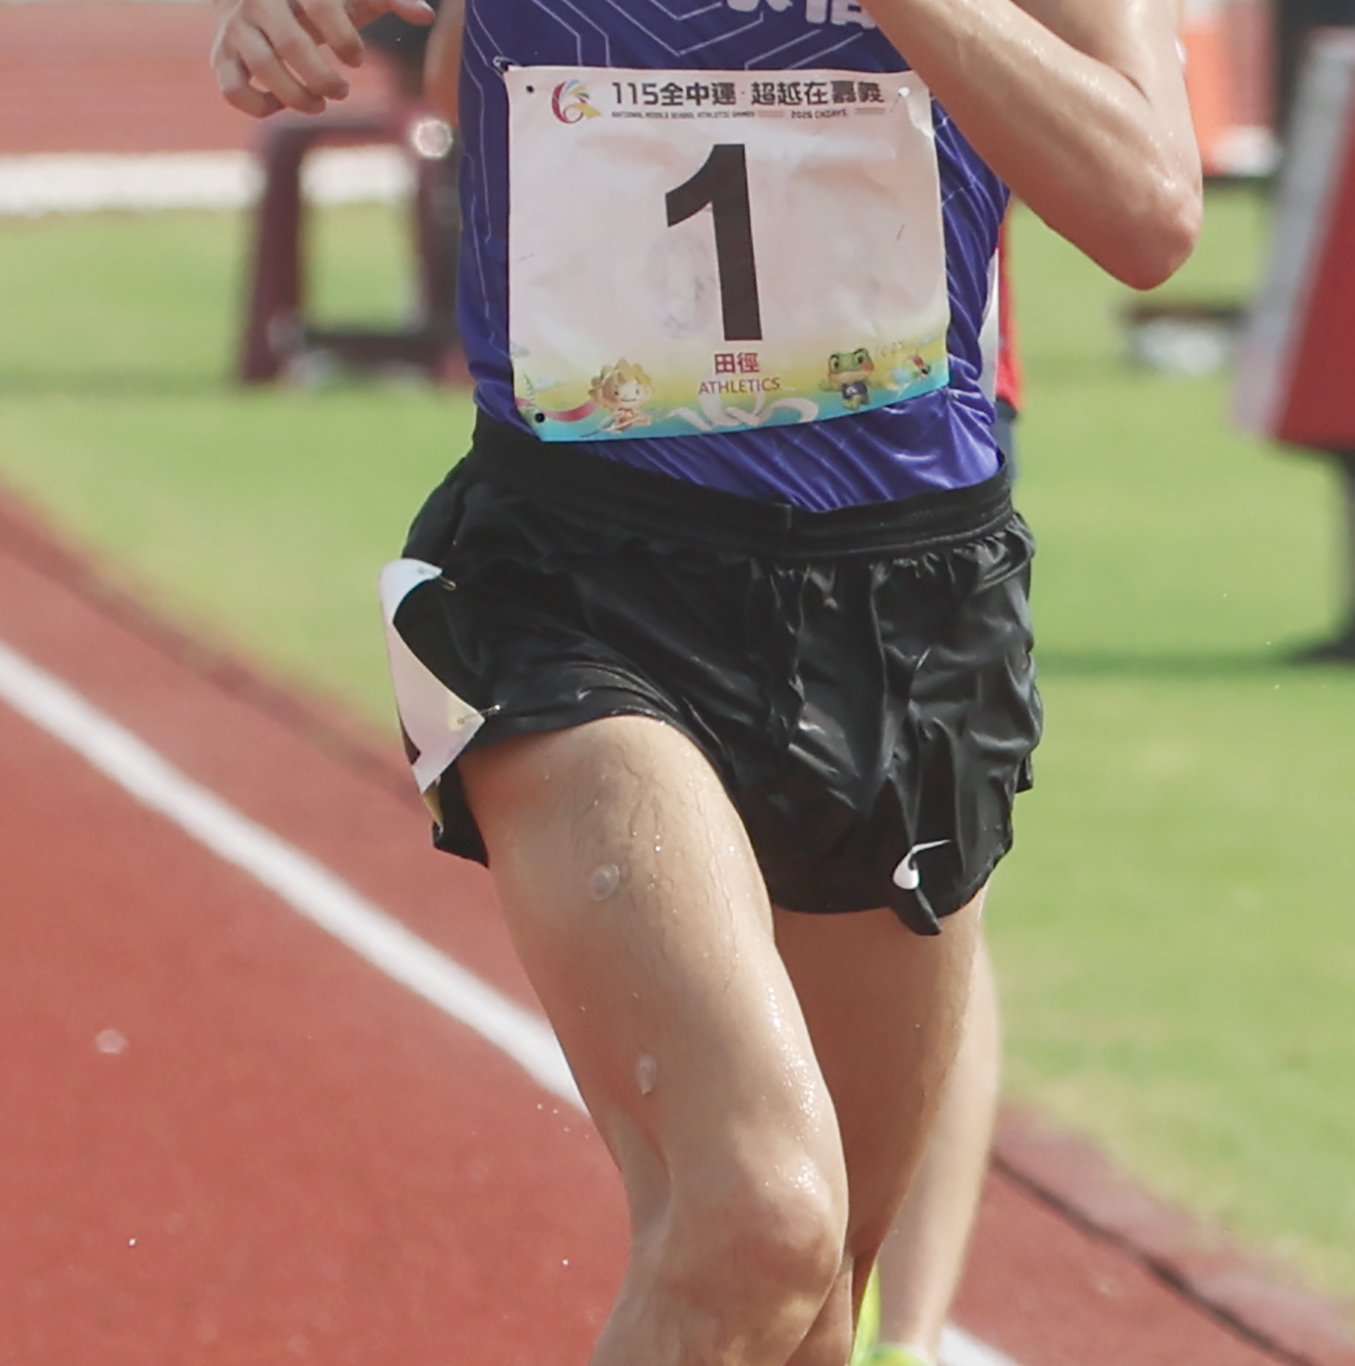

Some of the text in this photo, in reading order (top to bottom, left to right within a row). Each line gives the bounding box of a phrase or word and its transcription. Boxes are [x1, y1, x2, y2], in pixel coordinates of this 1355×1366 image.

[665, 143, 763, 341] 1
[714, 352, 761, 374] 田徑
[698, 376, 781, 395] ATHLETICS
